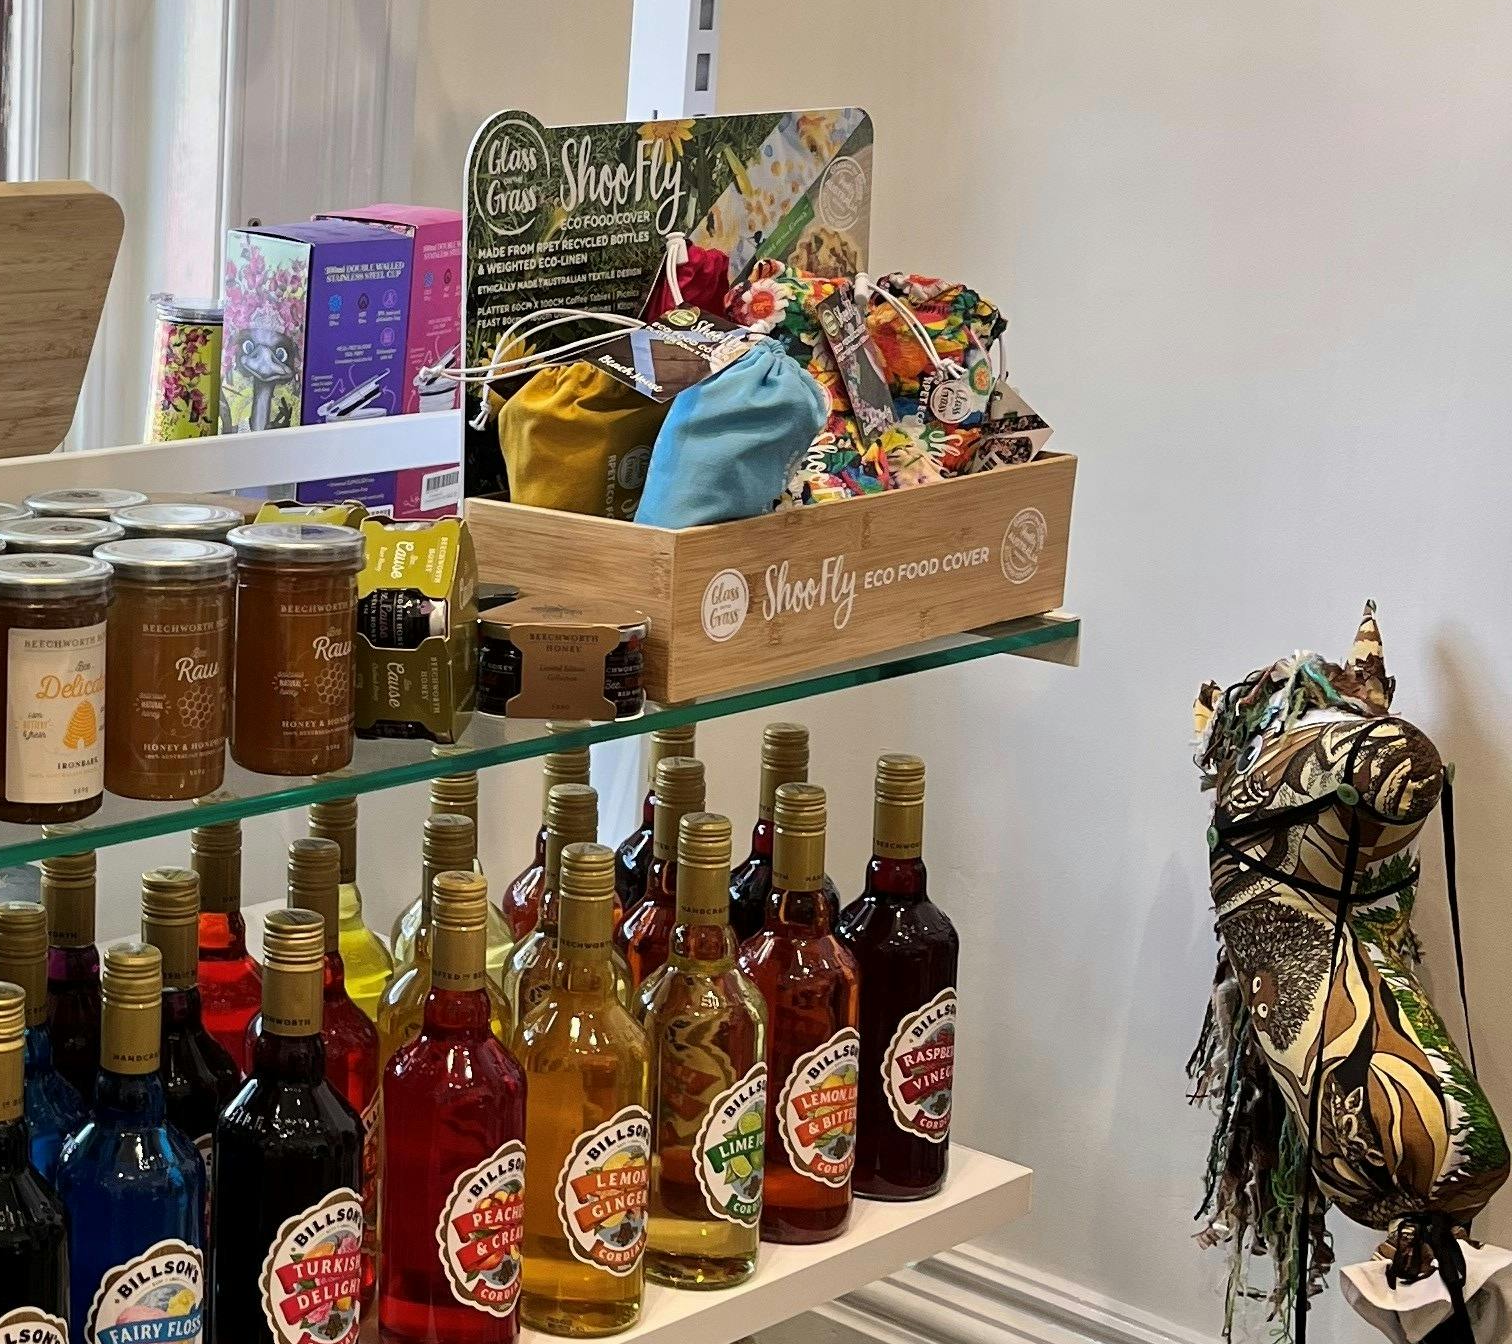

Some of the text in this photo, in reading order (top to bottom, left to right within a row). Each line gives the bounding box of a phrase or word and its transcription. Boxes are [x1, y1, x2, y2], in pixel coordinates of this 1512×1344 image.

[488, 136, 537, 175] Glass
[560, 135, 686, 235] ShooFly
[487, 179, 537, 216] Grass
[561, 210, 651, 232] ECO FOOD COVER
[478, 231, 650, 260] MADE FROM RPET RECYCLED BOTTLES
[478, 253, 588, 276] & WEIGHTED ECO-LINEN
[477, 268, 642, 295] ETHICALLY MADE TEXTILE DESIGN
[630, 371, 664, 393] House
[390, 540, 414, 580] Cause
[711, 581, 740, 605] Glass
[762, 546, 990, 630] ShooFly ECO FOOD COVER
[142, 622, 214, 634] BEECHWORTH
[710, 607, 740, 630] Grass
[24, 638, 95, 649] BEECHWORTH
[312, 636, 352, 661] Raw
[529, 633, 599, 643] BEECHWORTH
[546, 644, 583, 654] HONEY
[175, 657, 219, 683] Raw
[35, 672, 105, 700] Delicat
[388, 662, 405, 708] Cause
[281, 720, 316, 729] HONEY
[143, 743, 179, 752] HONEY
[57, 756, 99, 770] IRONBARK
[911, 1003, 956, 1039] BILLS
[903, 1044, 954, 1068] RASPBE
[724, 1079, 767, 1118] BILLS
[808, 1121, 819, 1135] &
[719, 1138, 755, 1159] LIME
[469, 1157, 524, 1198] BILLSO
[596, 1168, 648, 1189] LEMON
[476, 1241, 488, 1256] &
[117, 1258, 200, 1301] BILLSON'S
[108, 1312, 203, 1344] FAIRY FLOSS
